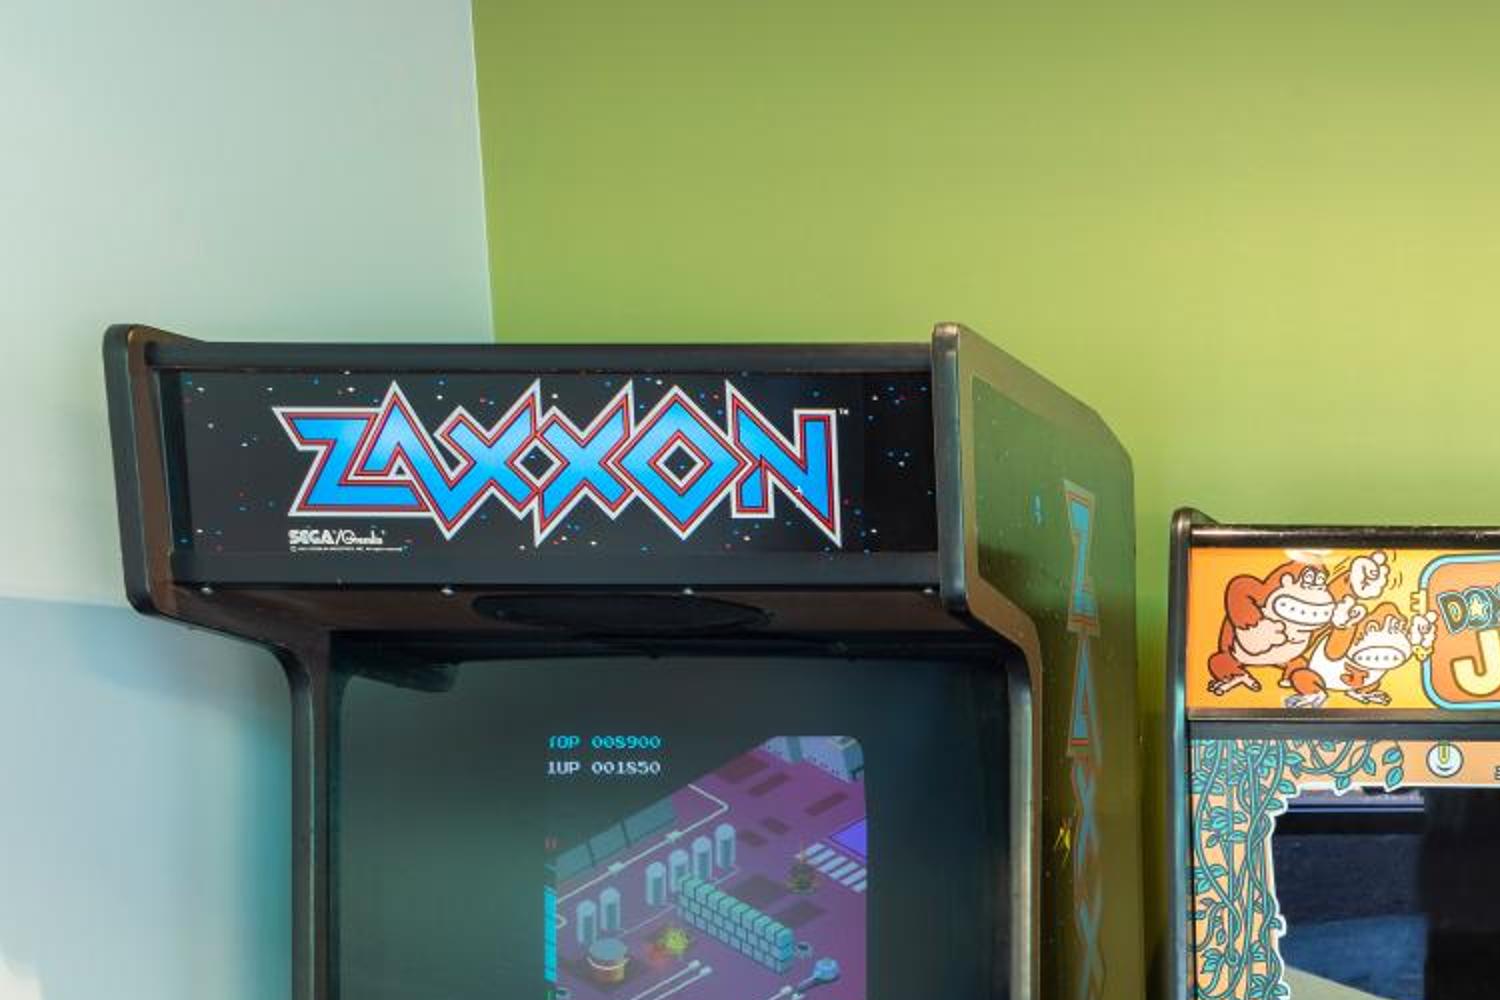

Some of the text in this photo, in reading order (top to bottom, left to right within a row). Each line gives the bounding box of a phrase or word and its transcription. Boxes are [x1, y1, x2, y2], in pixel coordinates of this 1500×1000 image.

[271, 380, 843, 548] ZAXXON
[591, 736, 661, 749] 008900
[548, 761, 580, 775] 1UP
